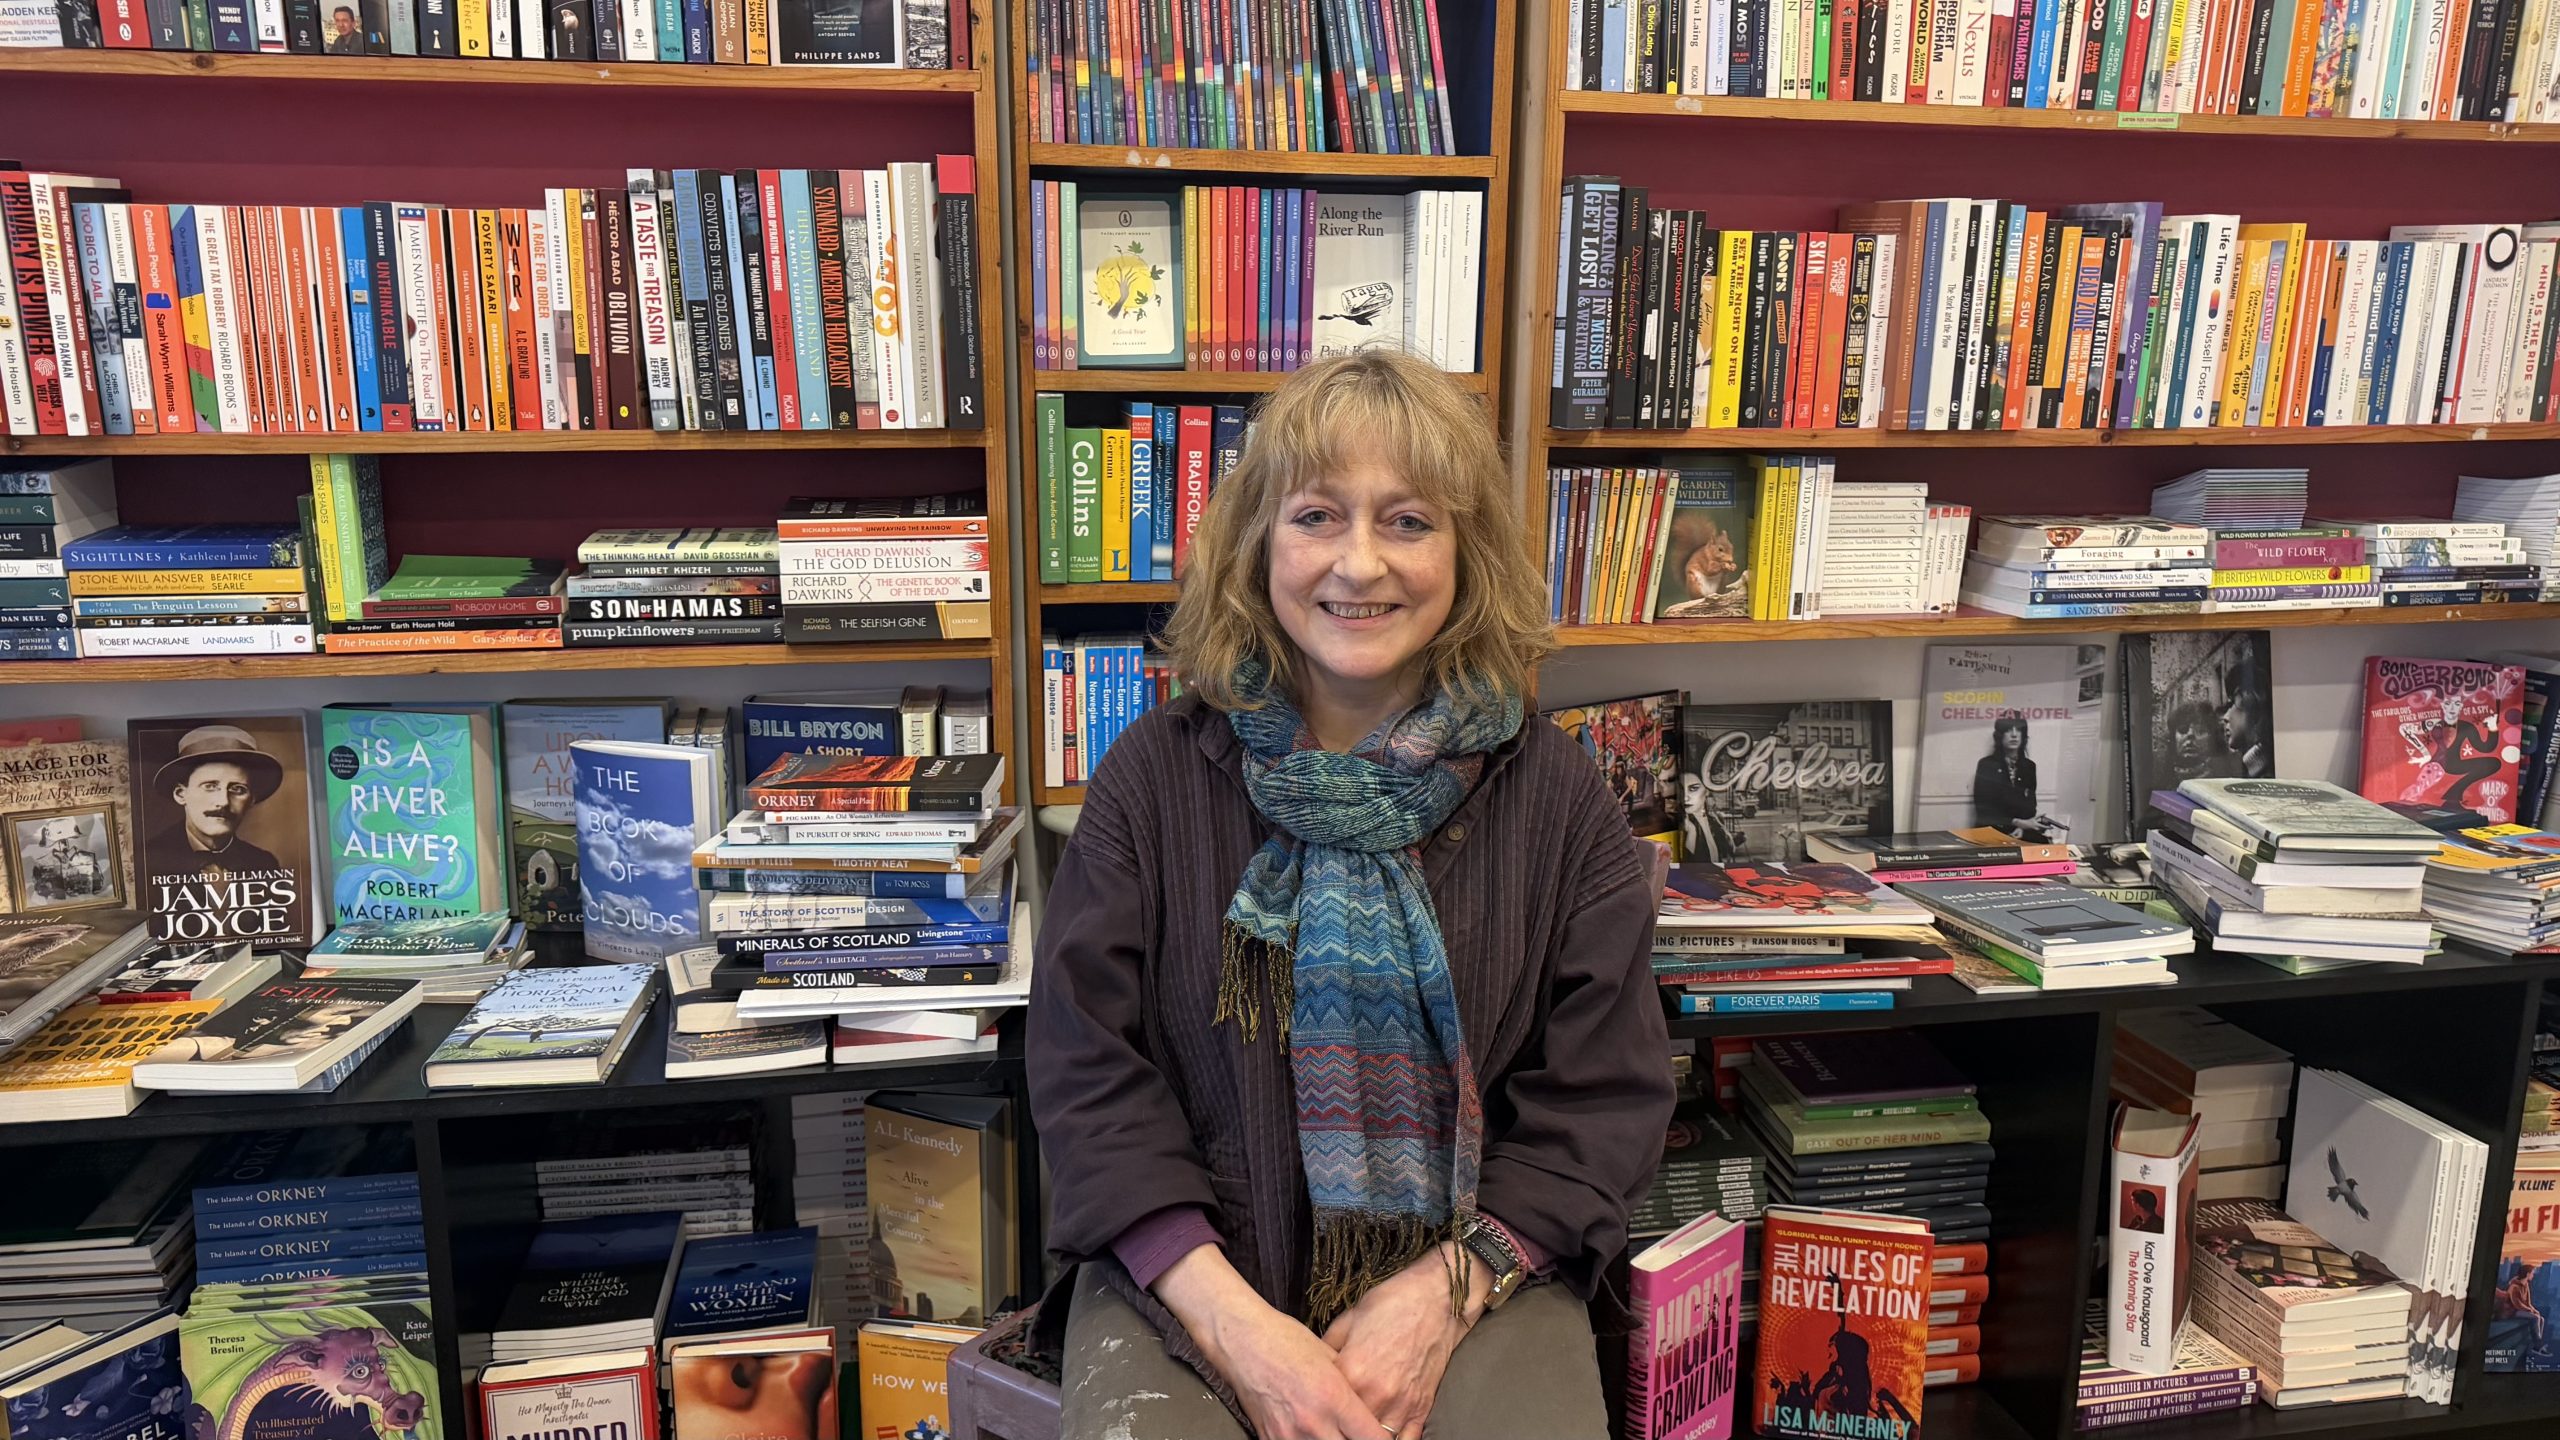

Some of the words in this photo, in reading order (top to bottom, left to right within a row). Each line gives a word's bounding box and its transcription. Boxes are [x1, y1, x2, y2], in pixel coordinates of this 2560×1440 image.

[218, 7, 241, 15] WENDY
[220, 15, 242, 24] MOORE
[1962, 10, 1985, 77] Nexus
[795, 51, 843, 61] PHILIPPE
[848, 51, 881, 60] SANDS
[34, 183, 48, 210] THE
[635, 203, 644, 214] A
[1320, 207, 1357, 222] Along
[1362, 207, 1382, 219] the
[7, 181, 37, 261] PRIVACY
[38, 210, 54, 240] ECHO
[144, 210, 158, 253] Careless
[204, 217, 215, 236] THE
[608, 200, 621, 247] HÉCTOR
[1319, 223, 1353, 236] River
[1358, 224, 1384, 236] Run
[481, 216, 494, 269] POVERTY
[636, 217, 657, 260] TASTE
[2221, 227, 2231, 251] Life
[205, 238, 219, 266] GREAT
[505, 223, 523, 299] WAR
[1809, 241, 1824, 274] SKIN
[44, 243, 62, 296] MACHINE
[150, 255, 161, 289] People
[610, 250, 622, 286] ABAD
[1776, 238, 1794, 292] doors
[2214, 255, 2227, 284] Time
[18, 266, 38, 286] IS
[209, 269, 221, 287] TAX
[2537, 265, 2549, 299] MIND
[486, 274, 497, 314] SAFARI
[1349, 282, 1389, 298] Tagus
[212, 288, 228, 330] ROBBERY
[376, 262, 396, 349] UNTHINKABLE
[643, 277, 666, 346] TREASON
[1733, 292, 1743, 332] NIGHT
[2534, 304, 2545, 316] IS
[22, 291, 55, 356] POWER
[608, 292, 629, 354] OBLIVION
[2204, 325, 2216, 361] Russell
[2530, 322, 2540, 346] THE
[218, 332, 234, 370] RICHARD
[1732, 336, 1739, 354] ON
[1728, 358, 1737, 386] FIRE
[2524, 351, 2536, 381] RIDE
[223, 373, 237, 409] BROOKS
[2196, 366, 2211, 400] Foster
[1185, 418, 1209, 426] Collins
[1072, 441, 1096, 537] Collins
[1132, 443, 1151, 519] GREEK
[1681, 481, 1727, 489] GARDEN
[1679, 490, 1728, 499] WILDLIFE
[72, 550, 160, 562] SIGHTLINES
[180, 551, 227, 561] Kathleen
[229, 551, 258, 562] Jamie
[584, 553, 597, 561] THE
[601, 552, 645, 561] THINKING
[646, 552, 675, 561] HEART
[683, 552, 709, 560] DAVID
[711, 551, 759, 560] GROSSMAN
[815, 548, 871, 558] RICHARD
[874, 547, 932, 557] DAWKINS
[2081, 549, 2124, 559] Foraging
[2258, 548, 2284, 558] WILD
[2288, 546, 2326, 557] FLOWER
[793, 558, 825, 570] THE
[830, 558, 866, 569] GOD
[872, 557, 952, 569] DELUSION
[79, 574, 118, 584] STONE
[122, 574, 149, 583] WILL
[153, 573, 203, 584] ANSWER
[210, 572, 253, 582] BEATRICE
[792, 577, 847, 588] RICHARD
[876, 578, 894, 587] THE
[896, 577, 932, 587] GENETIC
[935, 577, 961, 587] BOOK
[2226, 571, 2259, 583] BRITISH
[2261, 570, 2283, 583] WILD
[2286, 568, 2326, 582] FLOWERS
[211, 583, 245, 591] SEARLE
[788, 588, 853, 600] DAWKINS
[890, 587, 902, 597] OF
[904, 588, 922, 597] THE
[923, 587, 949, 596] DEAD
[590, 600, 641, 618] SON
[641, 604, 653, 613] OF
[654, 597, 743, 616] HAMAS
[571, 625, 695, 640] pumpkinflowers
[840, 618, 859, 628] THE
[861, 618, 897, 627] SELFISH
[900, 617, 926, 627] GENE
[99, 638, 130, 646] ROBERT
[132, 637, 190, 646] MACFARLANE
[202, 636, 255, 645] LANDMARKS
[337, 638, 356, 648] The
[357, 637, 399, 648] Practice
[402, 637, 413, 647] of
[415, 636, 430, 646] the
[432, 635, 456, 646] Wild
[1942, 708, 2015, 720] CHELSEA
[2020, 708, 2073, 720] HOTEL
[749, 719, 795, 738] BILL
[800, 720, 884, 739] BRYSON
[362, 738, 392, 765] IS
[407, 740, 431, 768] A
[1701, 730, 1886, 792] Chelsea
[593, 767, 640, 792] THE
[350, 784, 448, 816] RIVER
[758, 795, 816, 808] ORKNEY
[587, 814, 658, 840] BOOK
[343, 831, 458, 862] ALIVE?
[153, 872, 219, 885] RICHARD
[224, 869, 294, 881] ELLMANN
[609, 863, 640, 883] OF
[153, 880, 297, 912] JAMES
[367, 881, 439, 898] ROBERT
[158, 908, 290, 941] JOYCE
[586, 903, 684, 934] CLOUDS
[737, 937, 804, 951] MINERALS
[810, 935, 829, 948] OF
[833, 934, 909, 947] SCOTLAND
[917, 930, 963, 938] Livingstone
[1680, 936, 1735, 947] PICTURES
[1752, 937, 1788, 946] RANSOM
[1791, 937, 1819, 946] RIGGS
[793, 972, 854, 987] SCOTLAND
[1731, 996, 1784, 1007] FOREVER
[1787, 995, 1820, 1006] PARIS
[873, 1120, 899, 1137] A.L.
[904, 1126, 963, 1156] Kennedy
[257, 1186, 327, 1203] ORKNEY
[2518, 1180, 2556, 1191] KLUNE
[259, 1212, 328, 1227] ORKNEY
[261, 1240, 330, 1256] ORKNEY
[1774, 1243, 1799, 1273] THE
[2145, 1240, 2155, 1261] Karl
[1803, 1244, 1885, 1282] RULES
[1892, 1253, 1923, 1285] OF
[2143, 1262, 2154, 1287] Ove
[1771, 1276, 1921, 1321] REVELATION
[406, 1321, 427, 1329] Kate
[2140, 1288, 2154, 1348] Knausgaard
[207, 1336, 245, 1345] Theresa
[403, 1331, 432, 1341] Leiper
[210, 1345, 244, 1355] Breslin
[1764, 1405, 1802, 1428] LISA
[1808, 1407, 1912, 1440] McINERNEY
